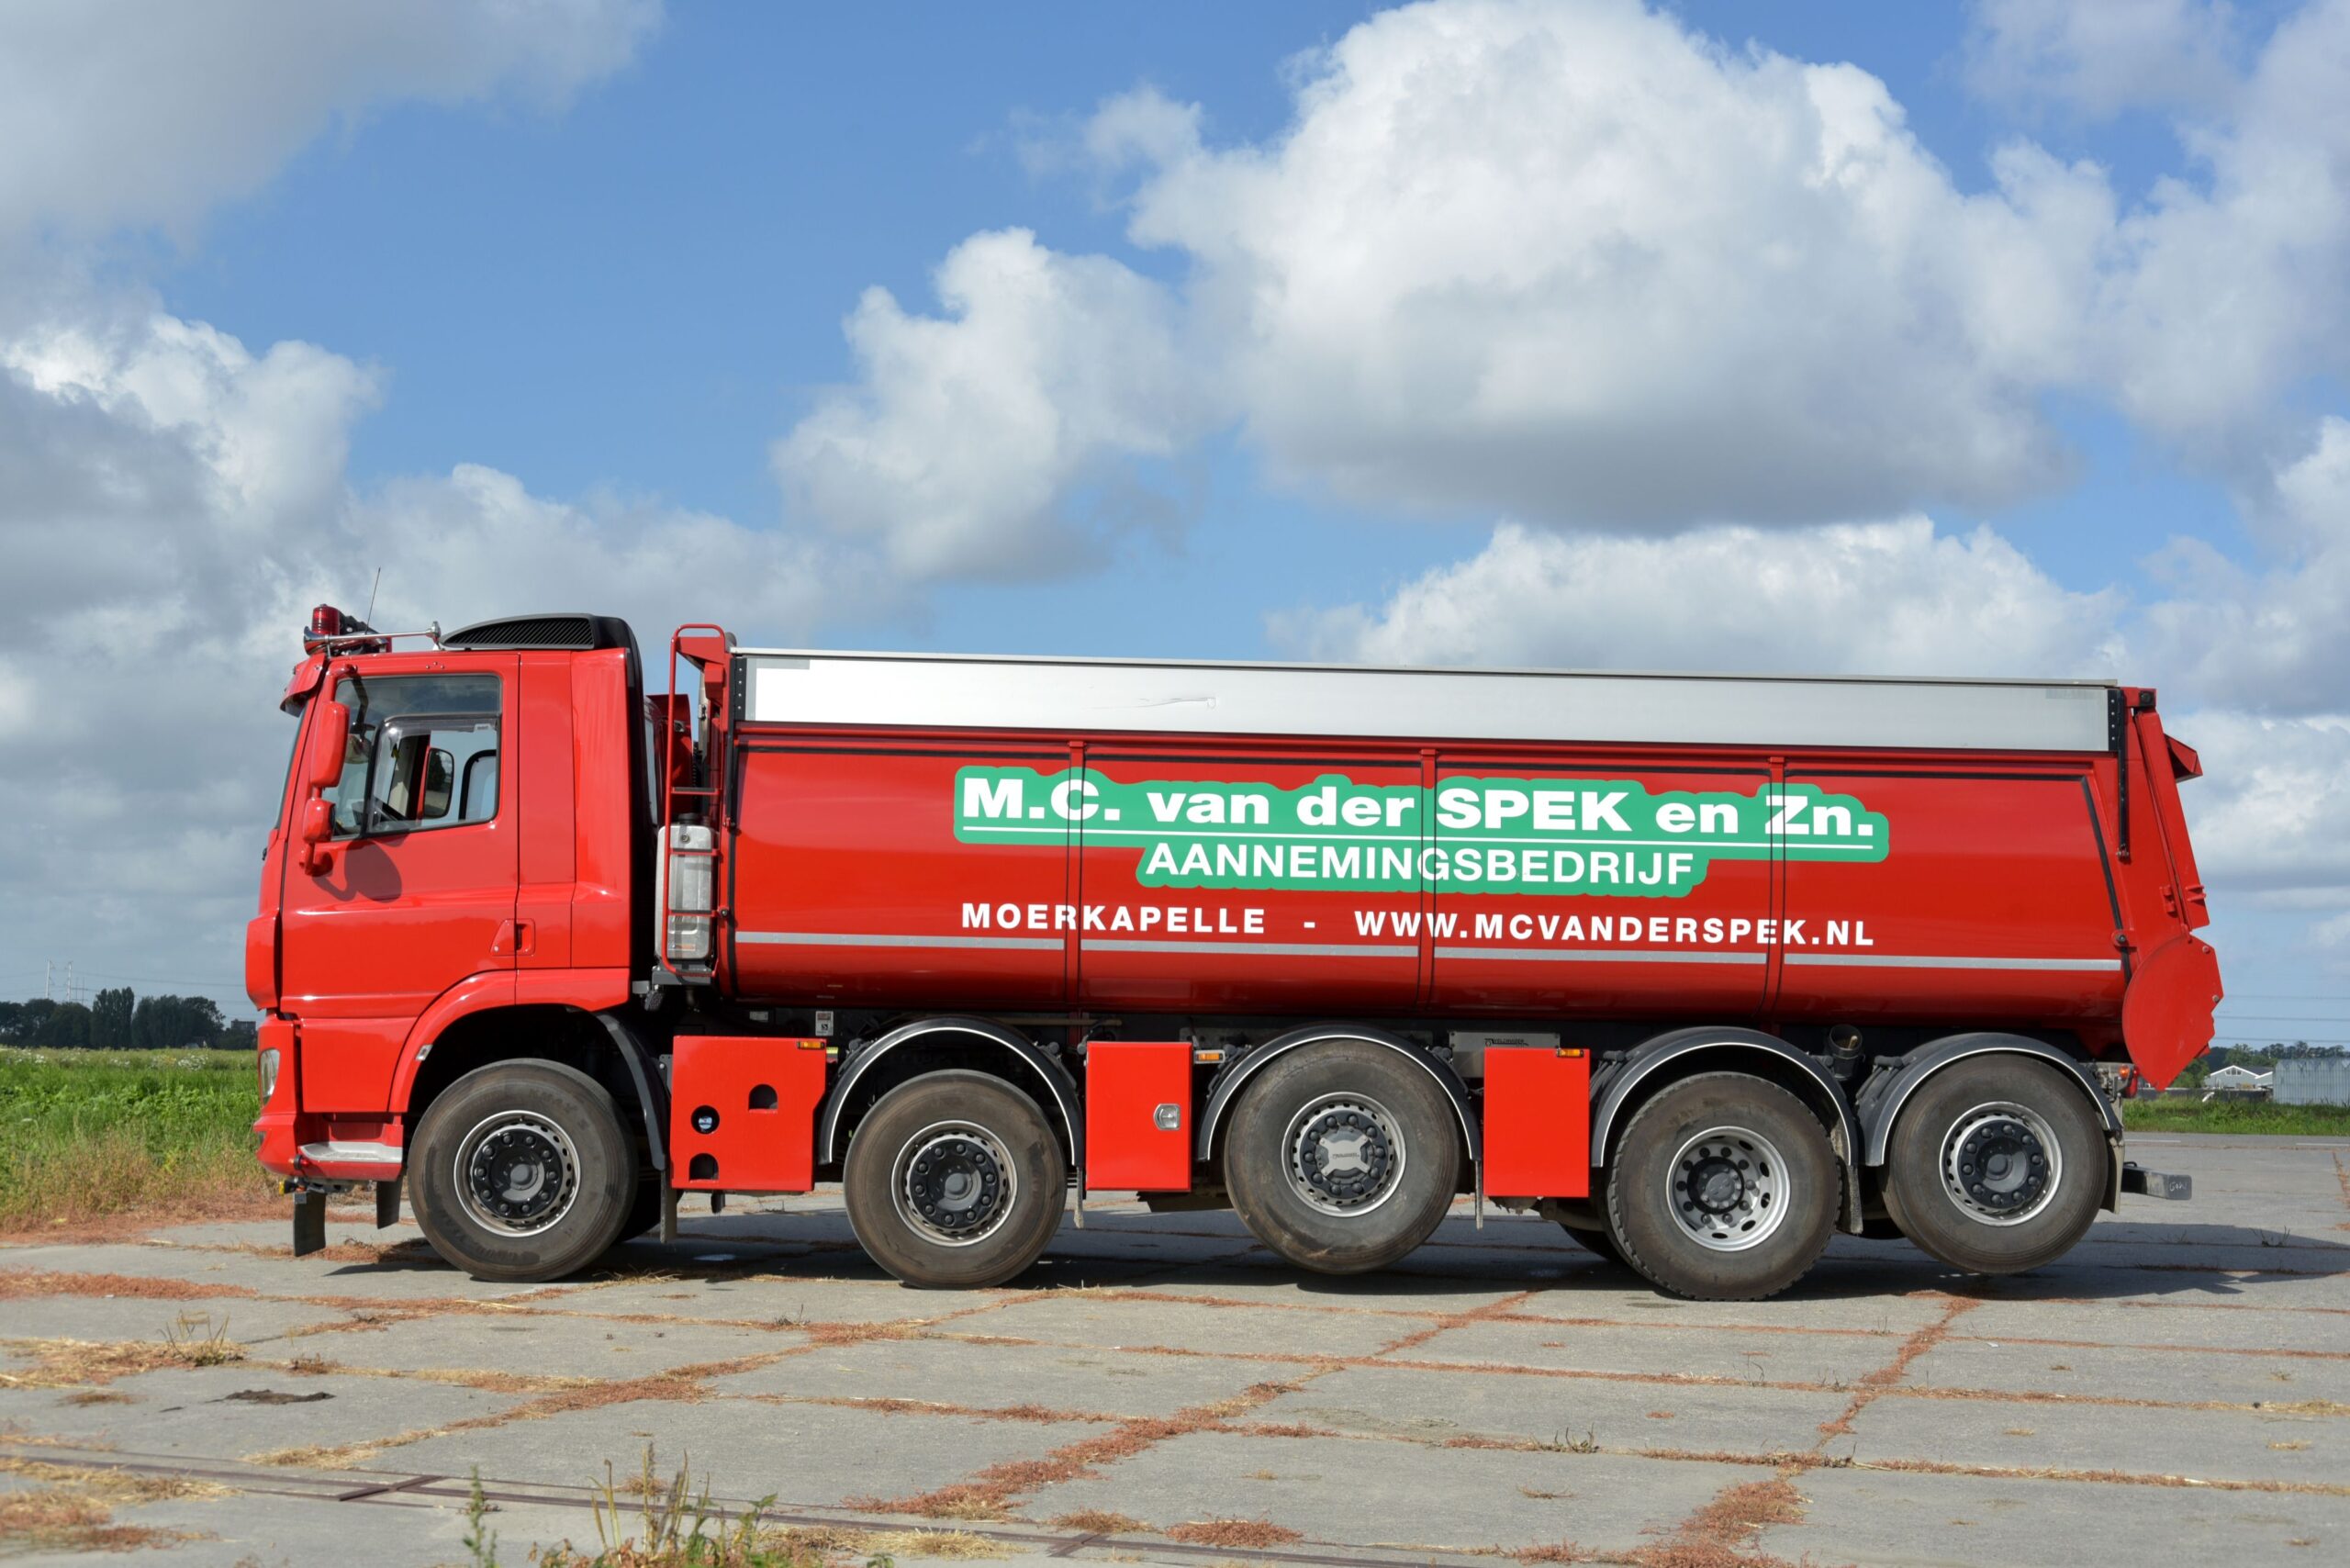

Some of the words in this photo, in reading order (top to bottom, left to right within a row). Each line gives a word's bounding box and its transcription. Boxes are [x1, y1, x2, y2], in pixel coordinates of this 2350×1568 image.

[963, 777, 1121, 822] M.C.
[1147, 792, 1270, 824] van
[1297, 786, 1416, 827] der
[1437, 788, 1632, 832] SPEK
[1656, 802, 1739, 834] en
[1764, 794, 1874, 836] Zn.
[1145, 842, 1694, 885] AANNEMINGSBEDRIJF
[962, 902, 1265, 934] MOERKAPELLE
[1354, 911, 1874, 946] WWW.MCVANDERSPEK.NL
